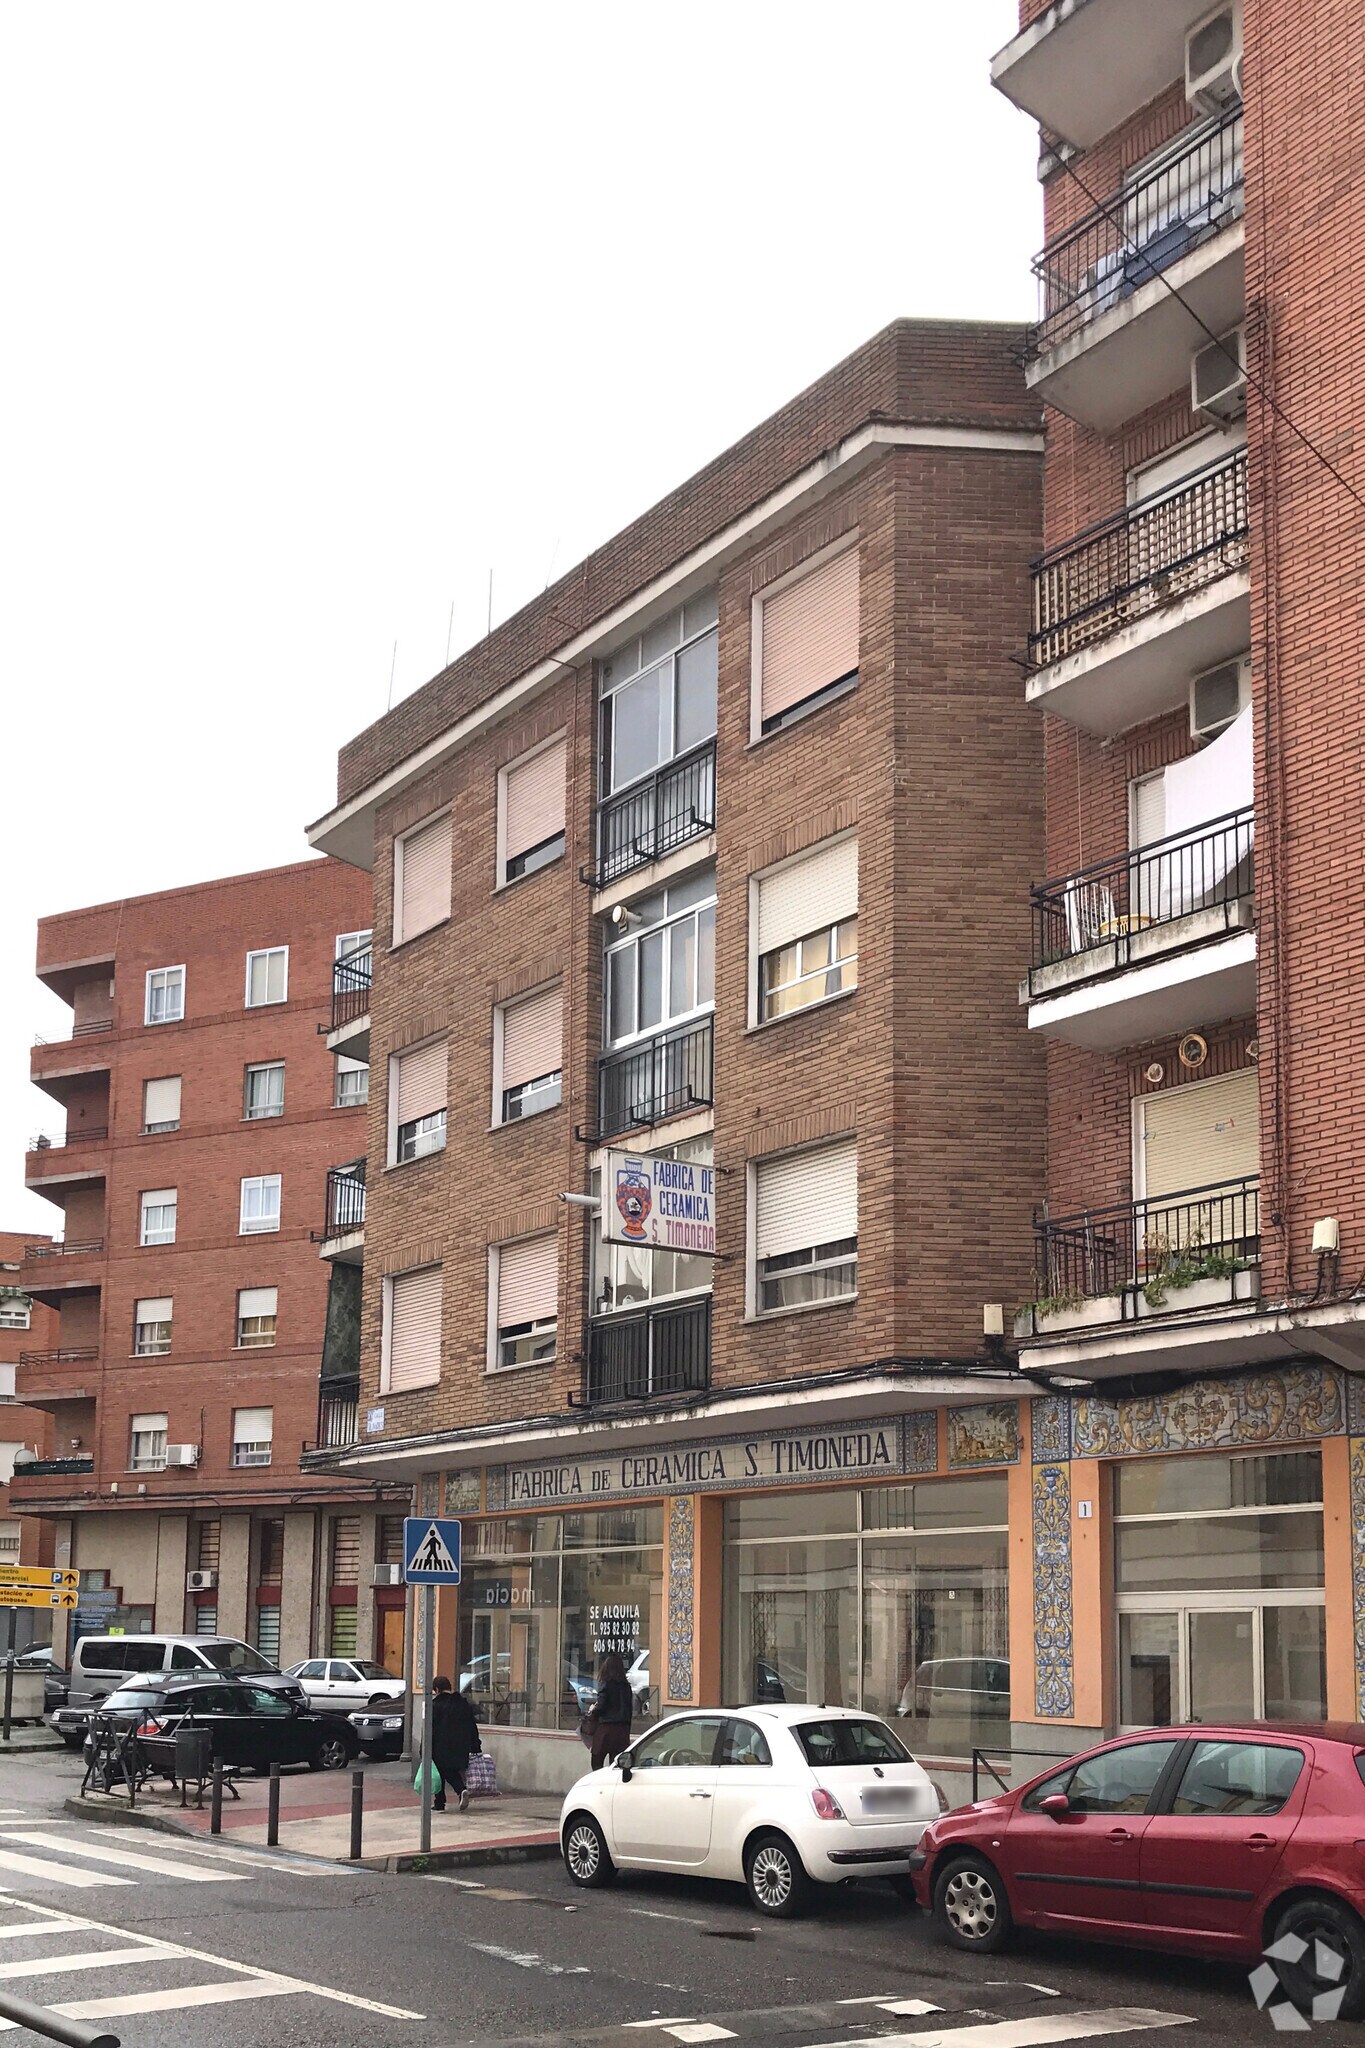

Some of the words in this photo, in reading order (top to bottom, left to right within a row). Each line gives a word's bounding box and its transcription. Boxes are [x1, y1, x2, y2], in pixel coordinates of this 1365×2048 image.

[653, 1161, 694, 1191] FABRICA
[701, 1169, 714, 1195] DE
[659, 1191, 710, 1222] CERAMICA
[652, 1218, 661, 1243] S.
[511, 1467, 583, 1500] FABRICA
[592, 1469, 611, 1492] DE
[621, 1450, 727, 1489] CERAMICA
[745, 1443, 763, 1477] S.
[771, 1432, 891, 1474] TIMONEDA
[53, 1572, 62, 1583] P
[589, 1605, 600, 1619] SE
[602, 1604, 640, 1620] ALQUILA
[599, 1621, 611, 1636] 925
[612, 1621, 620, 1636] 82
[621, 1621, 630, 1636] 30
[631, 1621, 640, 1636] 82
[593, 1638, 606, 1653] 606
[607, 1638, 616, 1653] 94
[626, 1638, 635, 1653] 94
